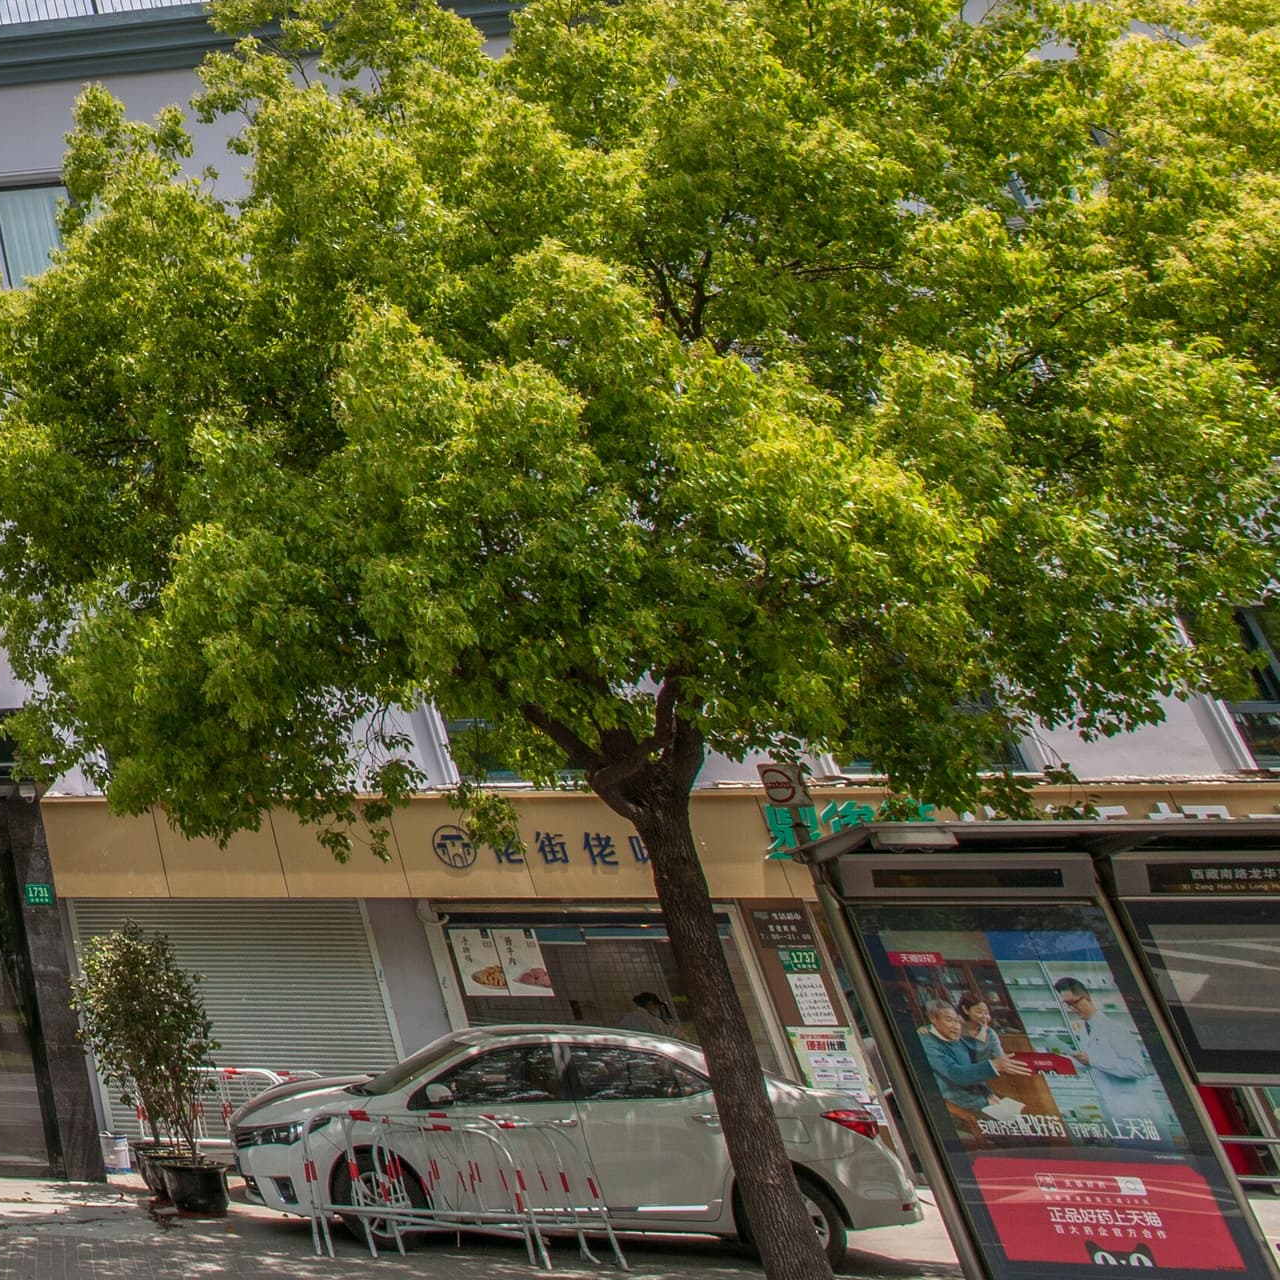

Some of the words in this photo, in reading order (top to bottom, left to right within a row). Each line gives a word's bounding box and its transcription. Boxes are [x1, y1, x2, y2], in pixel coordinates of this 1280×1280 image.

[28, 887, 49, 897] 1731
[791, 951, 815, 963] 1737
[1047, 1206, 1162, 1226] 正品好药上天猫
